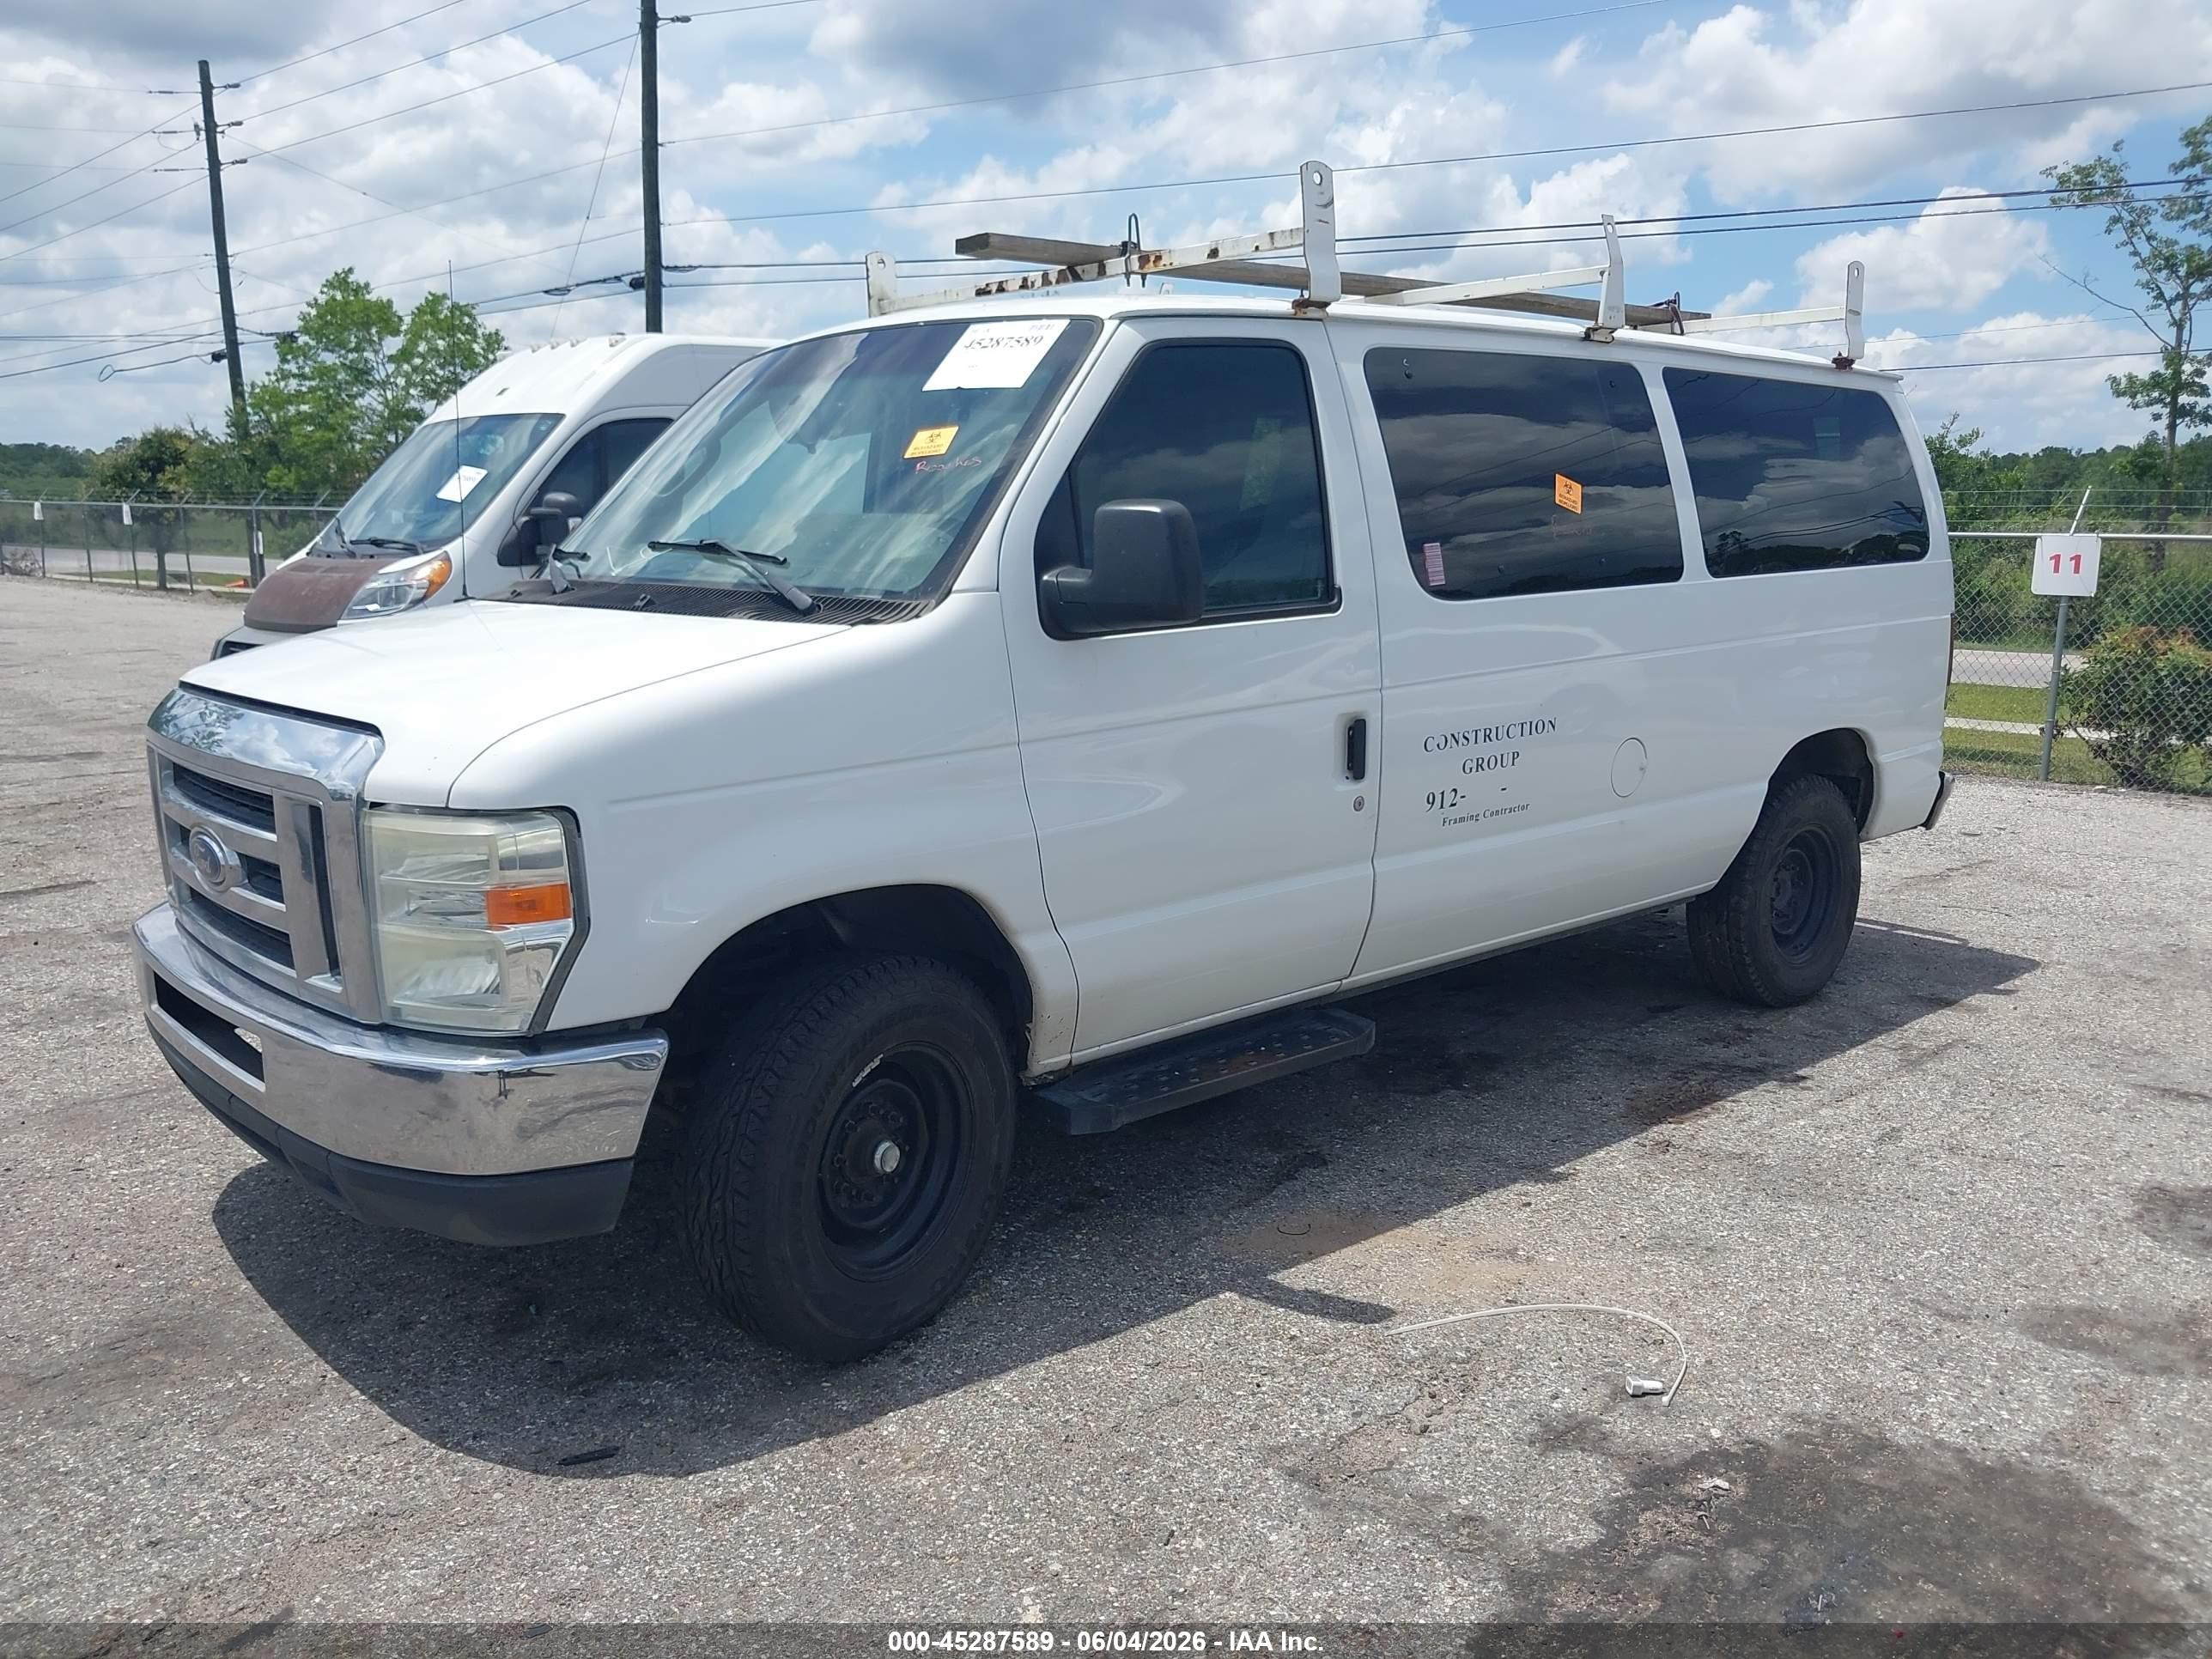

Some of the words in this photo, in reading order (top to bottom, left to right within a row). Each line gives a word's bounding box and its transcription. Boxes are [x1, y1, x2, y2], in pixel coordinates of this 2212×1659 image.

[2049, 553, 2082, 574] 11
[1424, 717, 1557, 753] CONSTRUCTION
[1462, 750, 1521, 775] GROUP
[1425, 787, 1467, 812] 912-
[1441, 811, 1480, 827] Framing
[1482, 802, 1530, 820] Contractor
